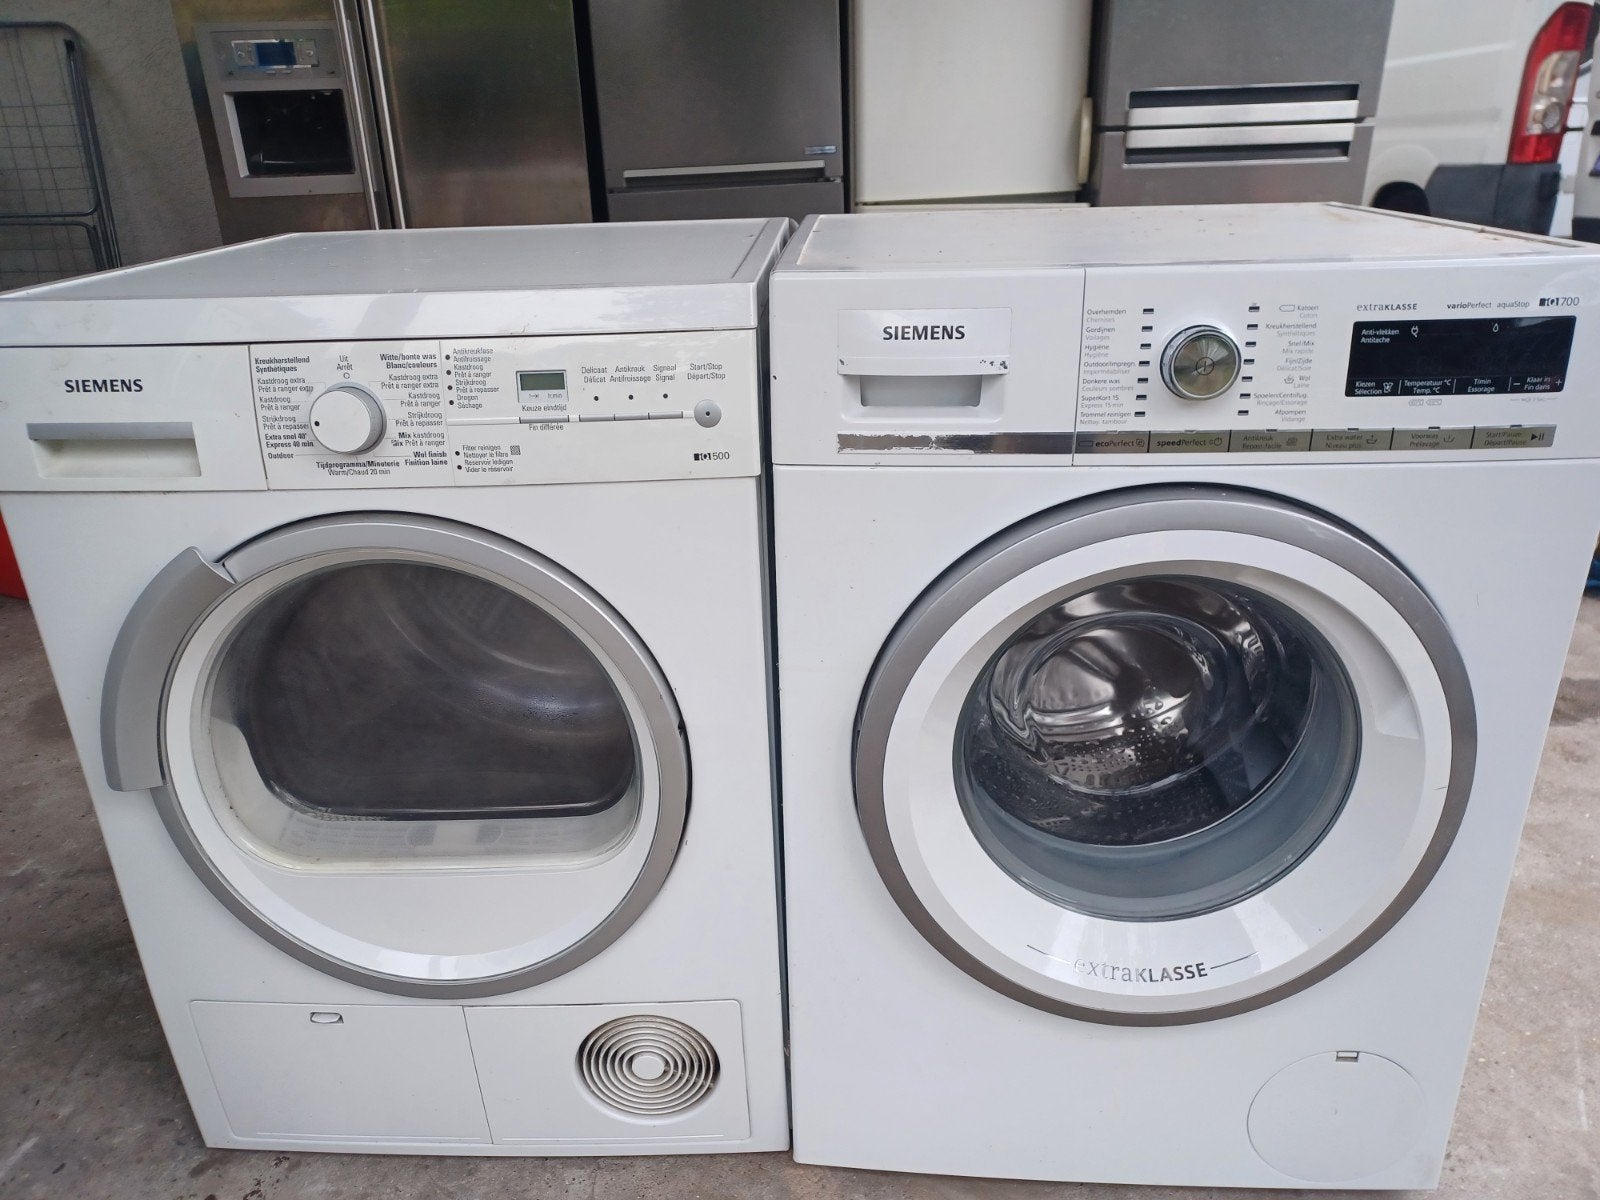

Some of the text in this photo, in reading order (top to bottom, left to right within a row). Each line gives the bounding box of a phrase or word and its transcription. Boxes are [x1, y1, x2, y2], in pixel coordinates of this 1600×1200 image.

[1356, 303, 1417, 311] extraKLASSE
[1446, 301, 1492, 309] varioPerfect
[1496, 300, 1530, 309] aquaStop
[883, 325, 965, 340] SIEMENS
[255, 356, 310, 364] Kreukherstellend
[380, 353, 420, 361] Witte/bonte
[1286, 357, 1312, 365] Fijn/Zijde
[256, 365, 297, 373] Synthétiques
[386, 361, 437, 369] Blanc/couleurs
[615, 365, 645, 373] Antikreuk
[653, 364, 676, 373] Signaal
[690, 363, 722, 371] Start/Stop
[581, 366, 607, 374] Delicaat
[389, 373, 420, 381] Kastdroog
[610, 375, 651, 383] Antifroissage
[655, 374, 675, 382] Signal
[687, 372, 726, 380] Départ/Stop
[64, 378, 143, 393] SIEMENS
[401, 382, 421, 390] ranger
[1404, 380, 1443, 388] Temperatuur
[408, 392, 440, 400] Kastdroog
[544, 404, 567, 412] eindtijd
[262, 415, 296, 423] Strijkdroog
[266, 441, 291, 449] Express
[405, 439, 418, 447] Prêt
[1156, 439, 1206, 448] speedPerfect
[316, 460, 400, 469] Tijdprogramma/Minuterie
[328, 468, 368, 476] Warm/Chaud
[1074, 959, 1208, 983] extraKLASSE
